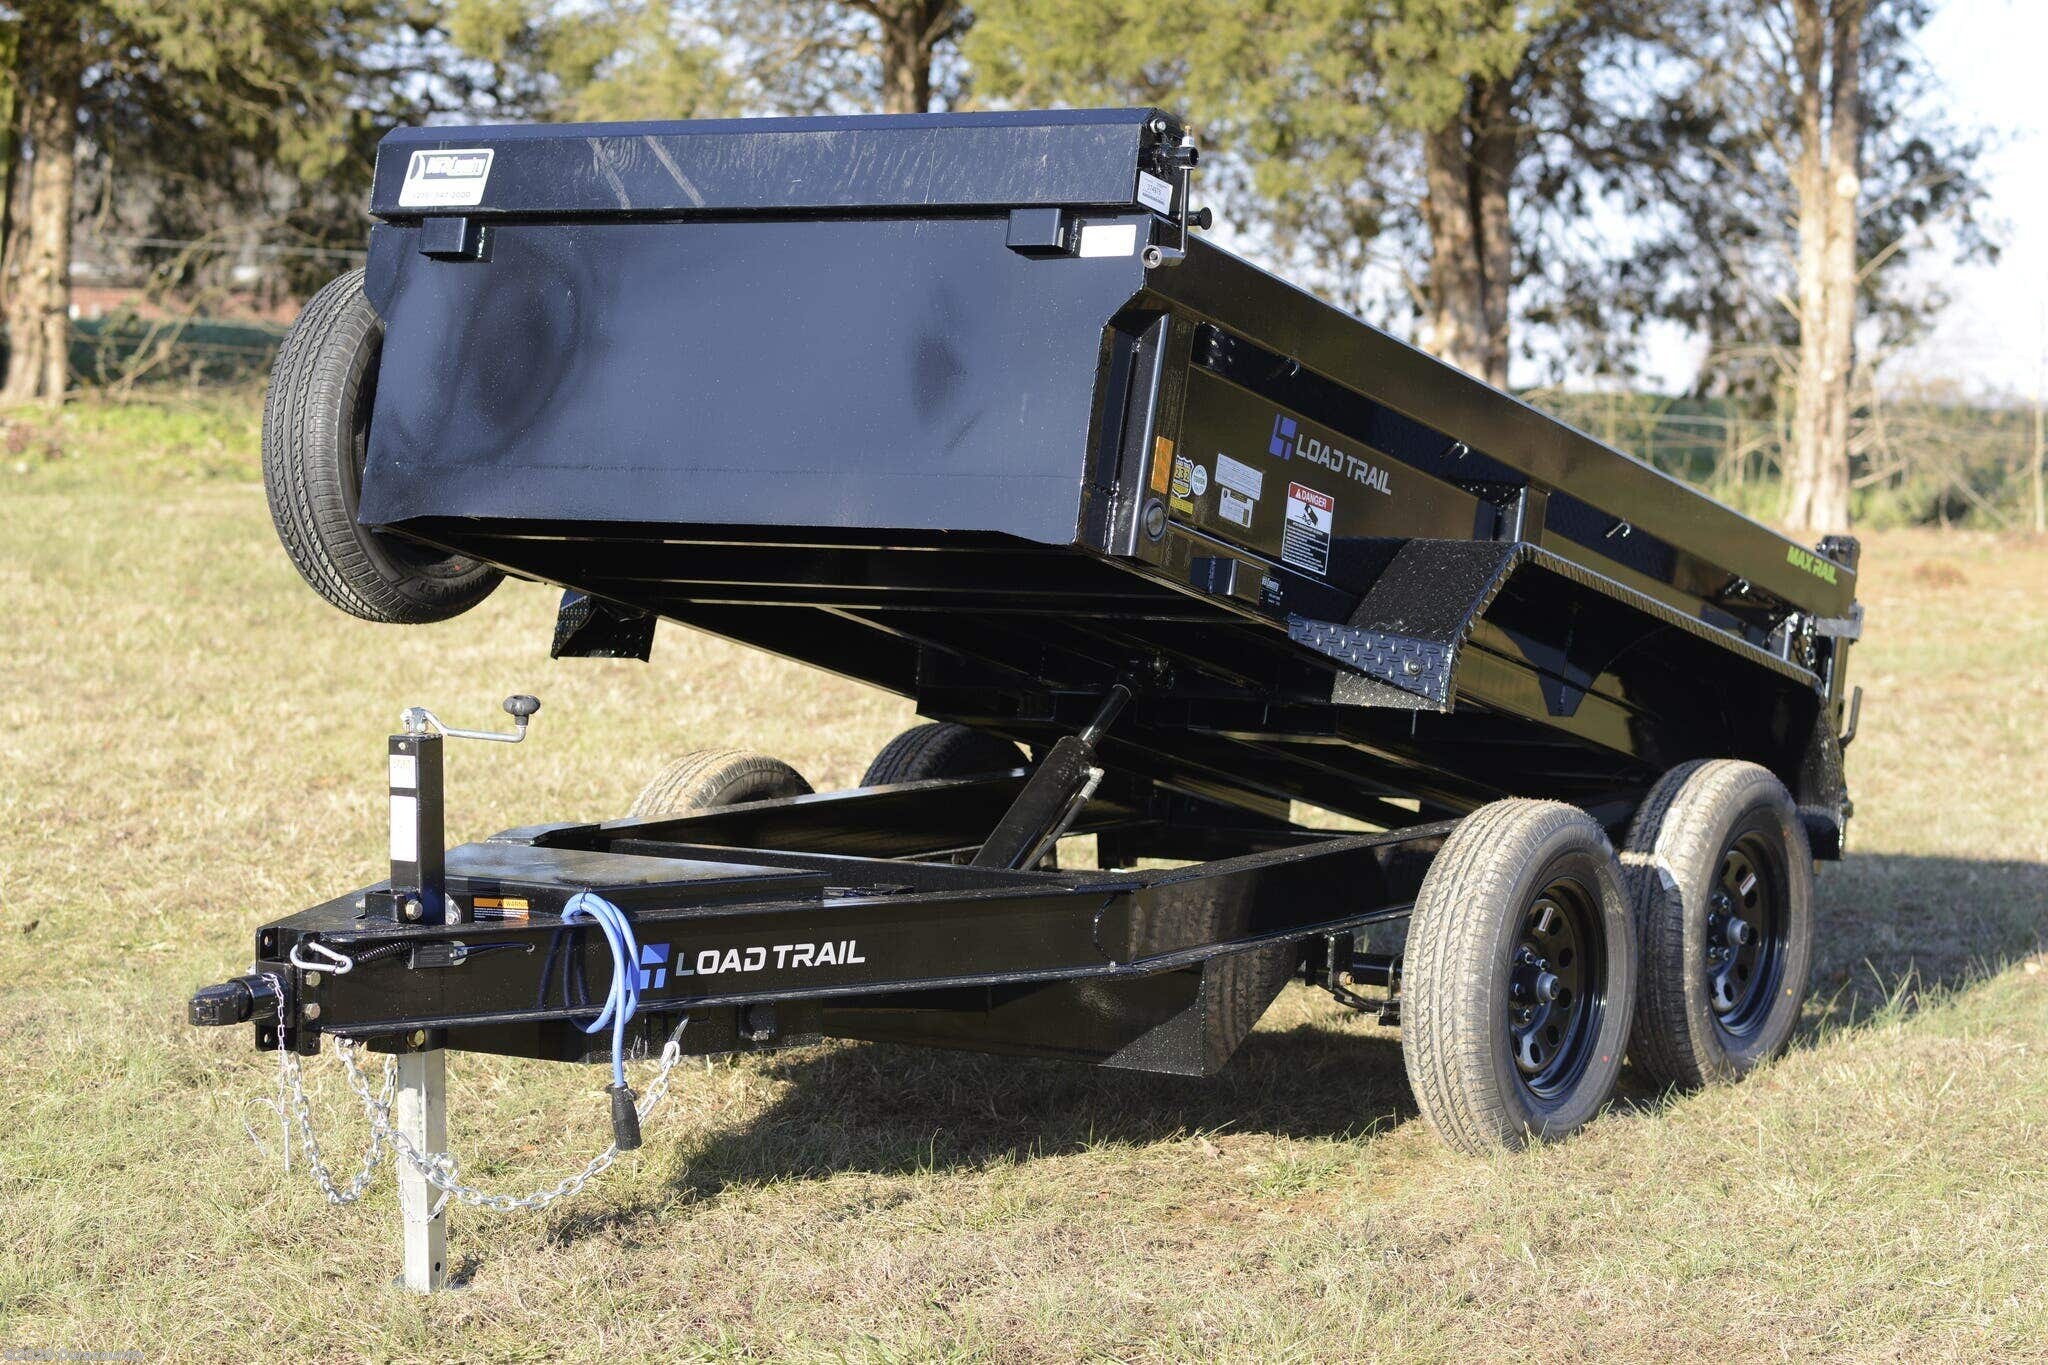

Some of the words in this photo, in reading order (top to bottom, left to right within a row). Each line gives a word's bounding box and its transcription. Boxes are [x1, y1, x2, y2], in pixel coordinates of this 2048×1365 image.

[1296, 434, 1344, 472] LOAD
[1346, 454, 1391, 495] TRAIL
[1301, 489, 1327, 509] DANGER
[1786, 544, 1814, 573] MAX
[1812, 557, 1837, 586] RAIL
[676, 946, 767, 976] LOAD
[773, 939, 866, 969] TRAIL
